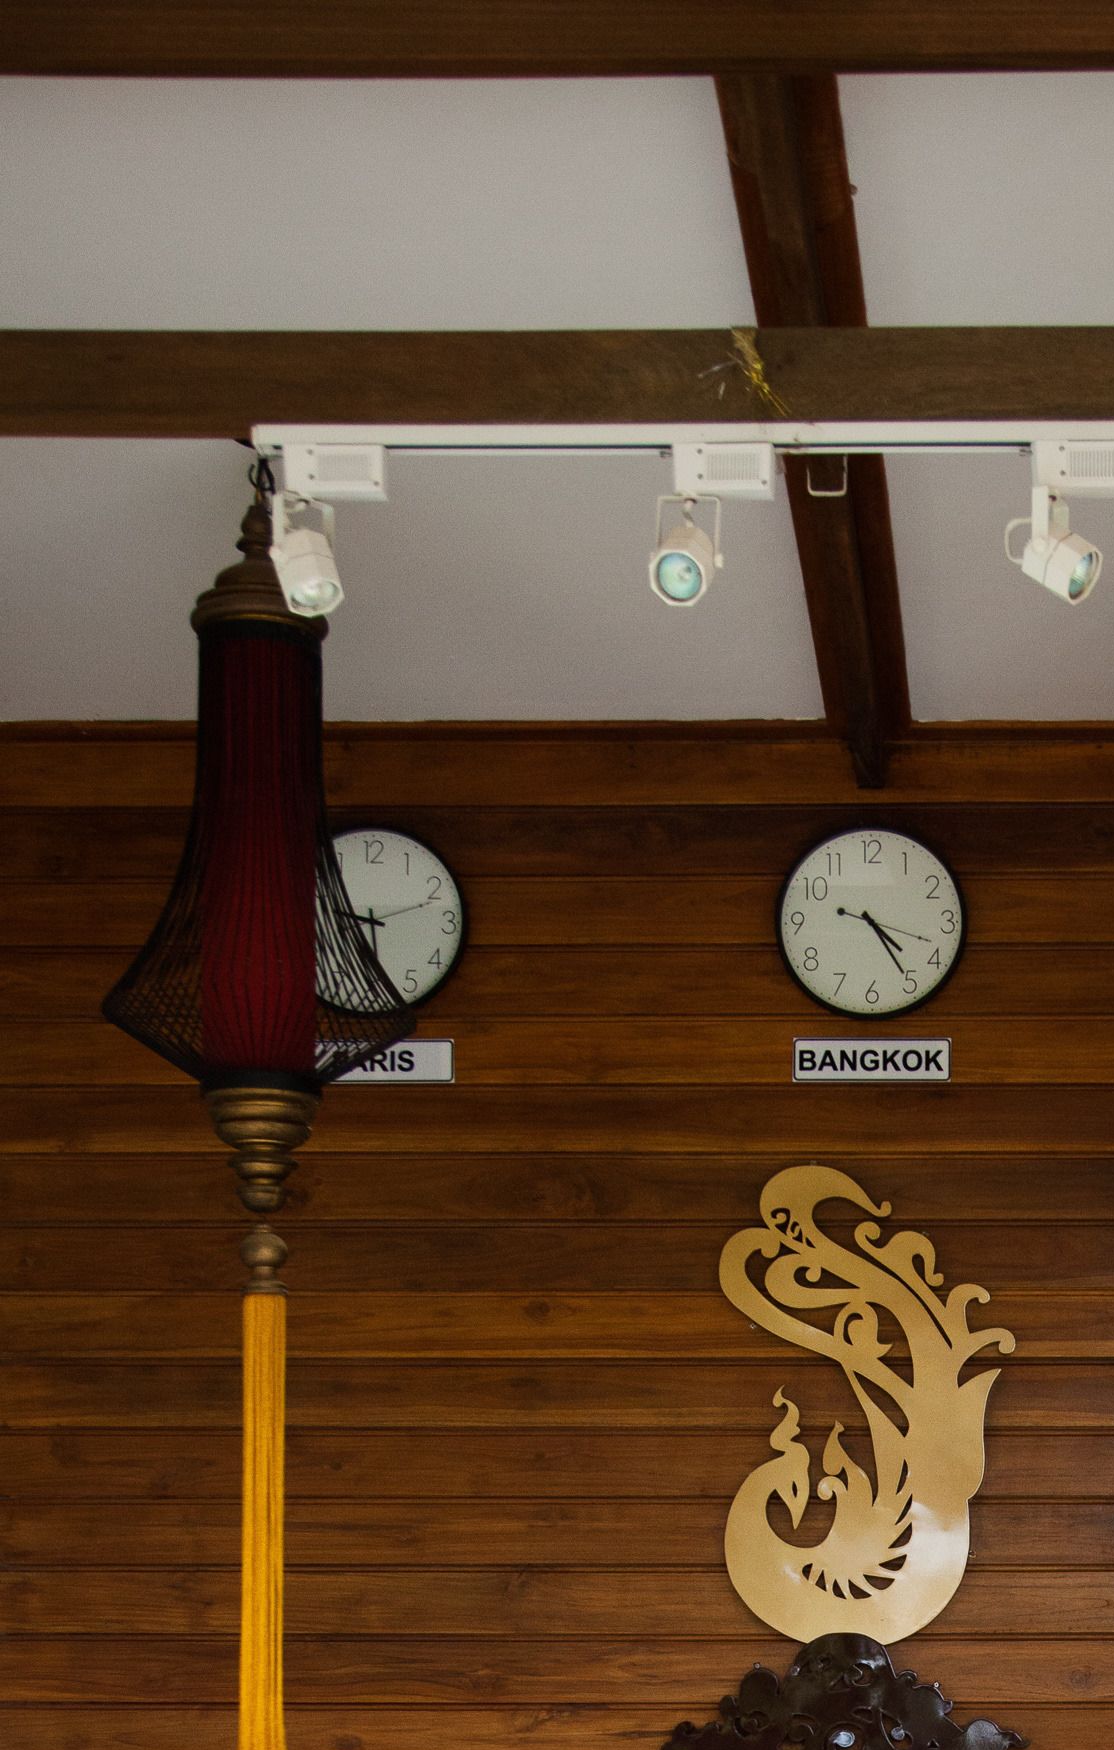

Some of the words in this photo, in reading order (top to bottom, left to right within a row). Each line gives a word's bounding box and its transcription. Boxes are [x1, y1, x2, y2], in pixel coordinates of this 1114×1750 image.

[363, 840, 385, 864] 12
[826, 852, 841, 876] 11
[862, 840, 882, 864] 12
[902, 852, 908, 875] 1
[404, 853, 410, 876] 1
[426, 876, 442, 900] 2
[803, 876, 828, 901] 10
[925, 875, 940, 899] 2
[441, 910, 457, 935] 3
[790, 911, 805, 936] 9
[940, 910, 956, 934] 3
[427, 948, 442, 969] 4
[803, 947, 819, 972] 8
[927, 947, 942, 969] 4
[402, 970, 418, 993] 5
[833, 972, 846, 997] 7
[865, 980, 879, 1004] 6
[902, 970, 917, 994] 5
[799, 1050, 944, 1072] BANGKOK
